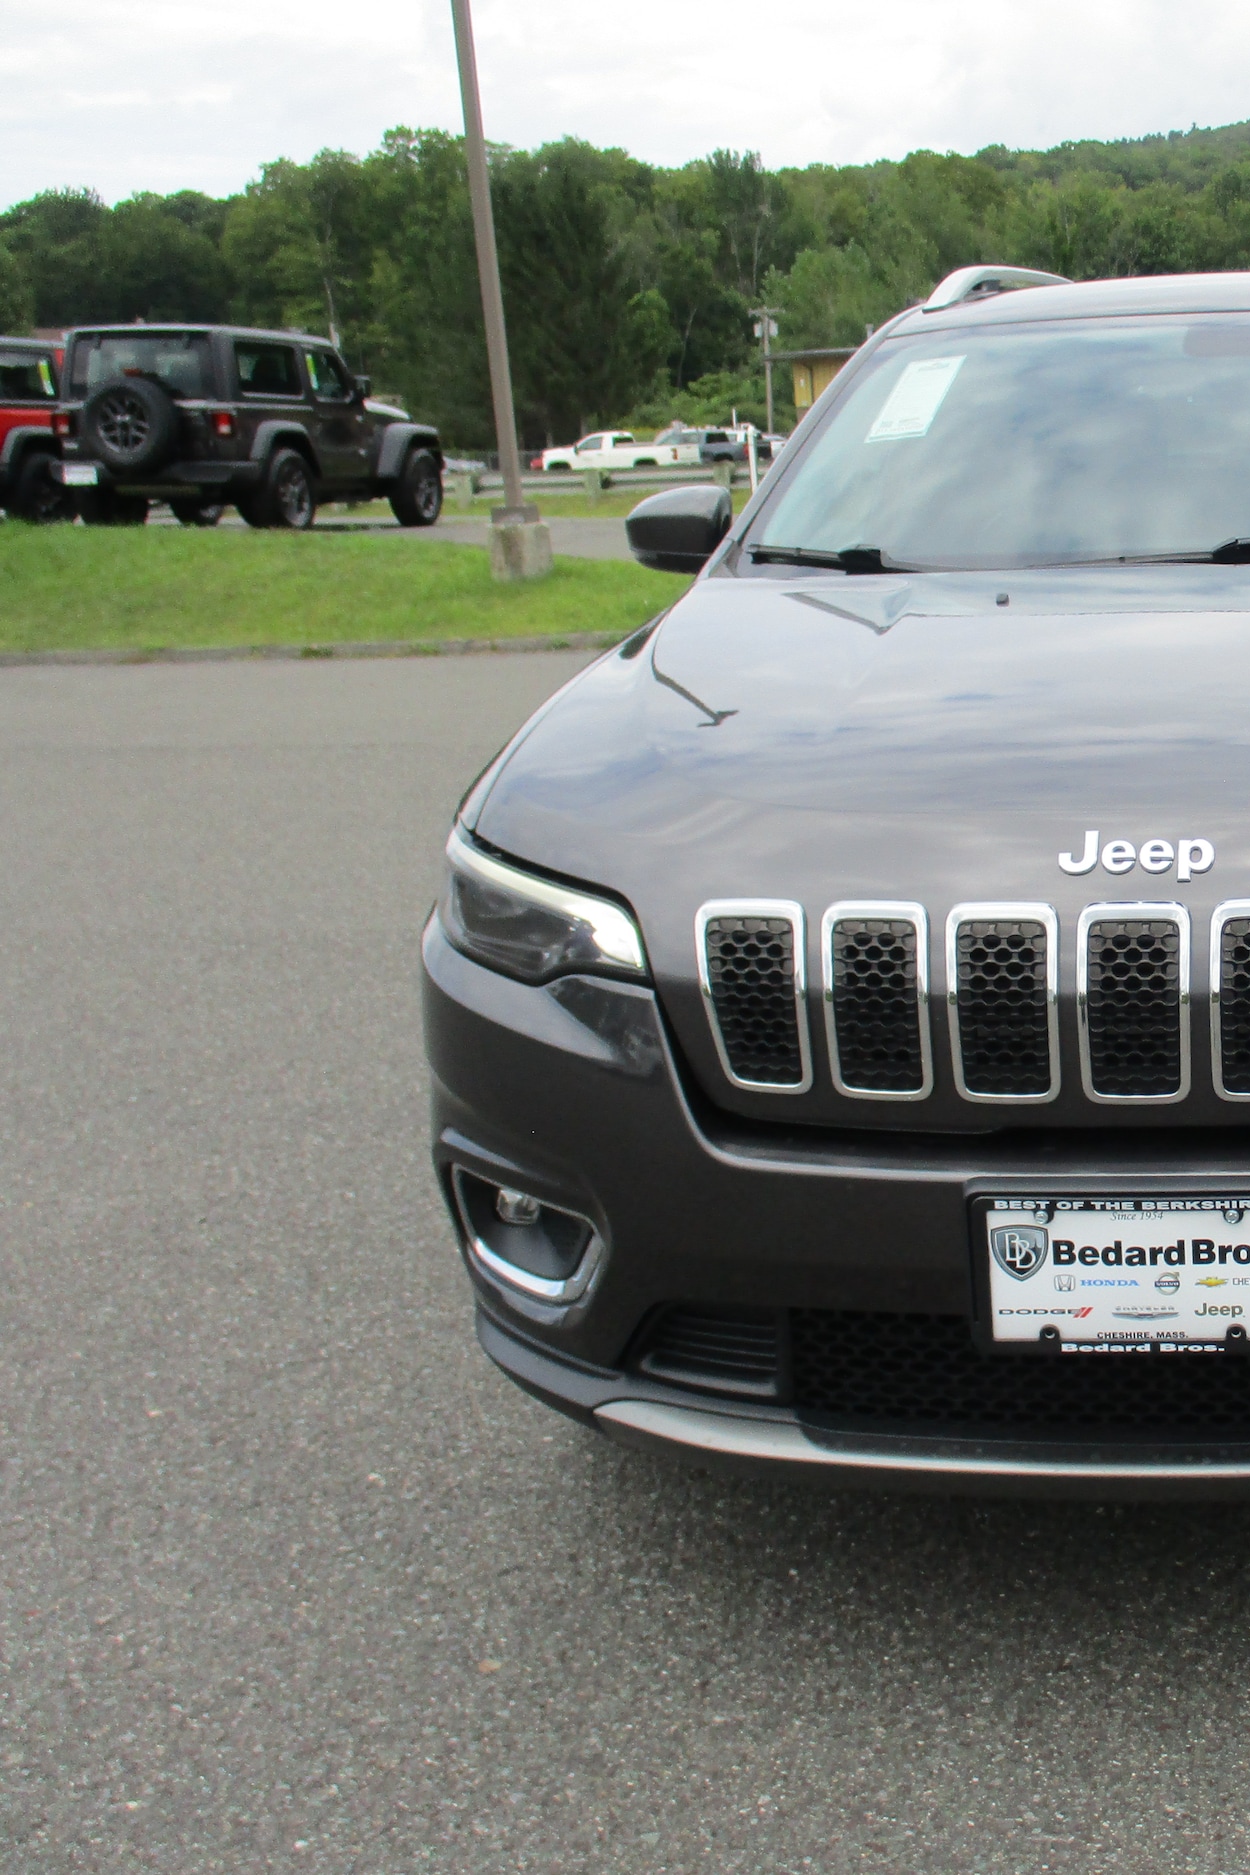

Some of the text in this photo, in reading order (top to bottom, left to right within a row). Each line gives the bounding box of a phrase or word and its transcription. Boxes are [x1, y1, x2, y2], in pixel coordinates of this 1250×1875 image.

[1058, 830, 1215, 883] Jeep
[994, 1200, 1050, 1210] BEST
[1056, 1200, 1085, 1210] OF
[1091, 1200, 1135, 1210] THE
[1111, 1210, 1164, 1221] Since 1954
[1052, 1239, 1186, 1266] Bedard
[1080, 1279, 1140, 1287] HONDA
[998, 1308, 1078, 1316] DODGE
[1194, 1303, 1243, 1318] Jeep
[1156, 1331, 1189, 1339] MASS.
[1061, 1343, 1226, 1353] Bedard Bros.
